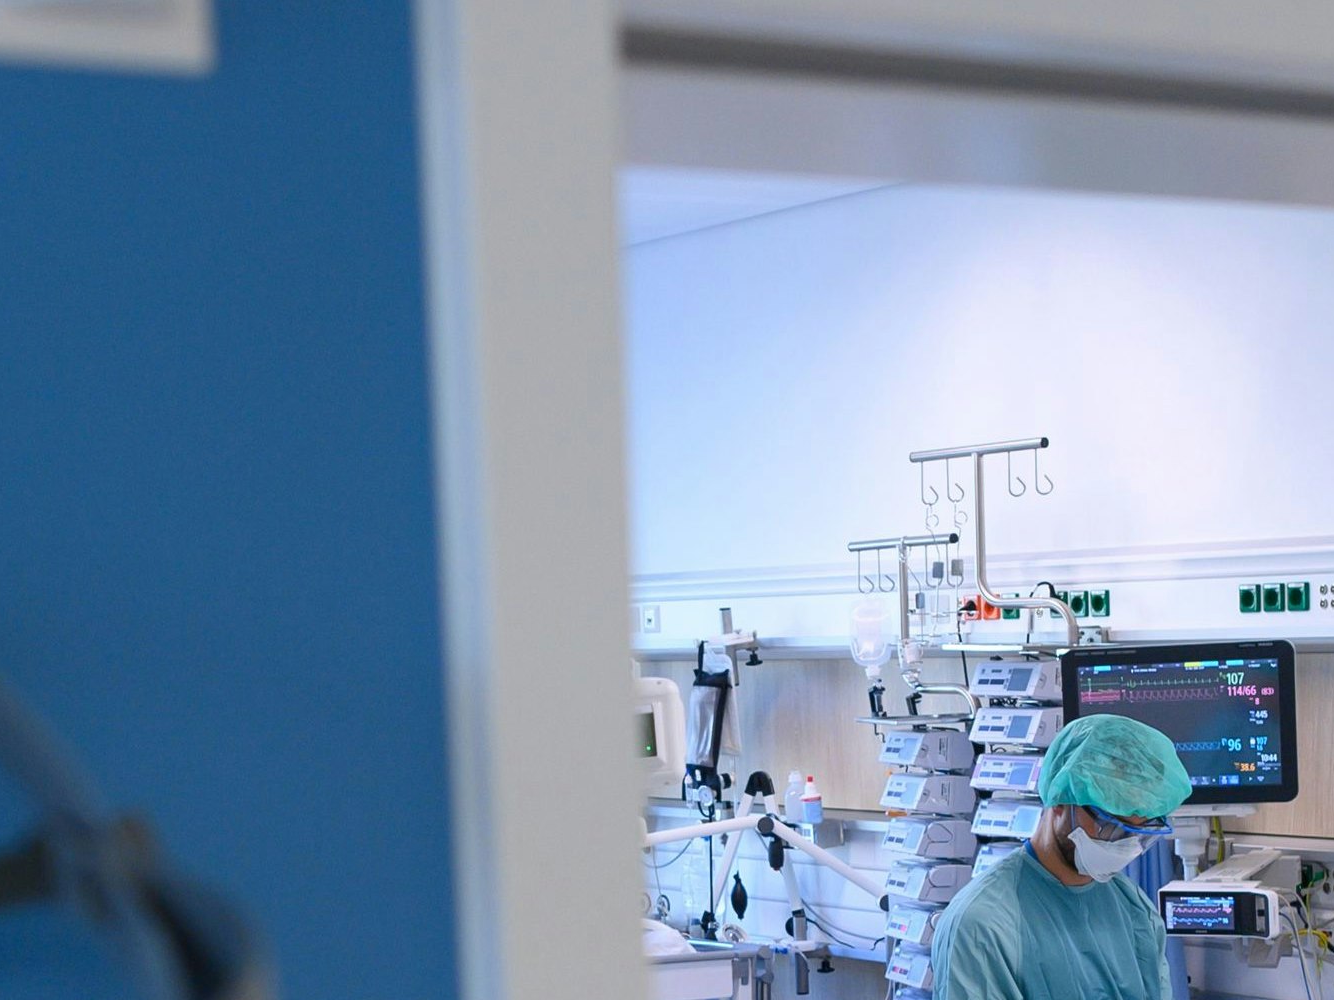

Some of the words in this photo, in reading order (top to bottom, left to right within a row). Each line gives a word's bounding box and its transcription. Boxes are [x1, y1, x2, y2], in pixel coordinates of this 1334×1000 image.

[1226, 672, 1244, 685] 107
[1227, 685, 1257, 697] 114/66
[1255, 710, 1268, 719] 445
[1227, 738, 1242, 751] 96
